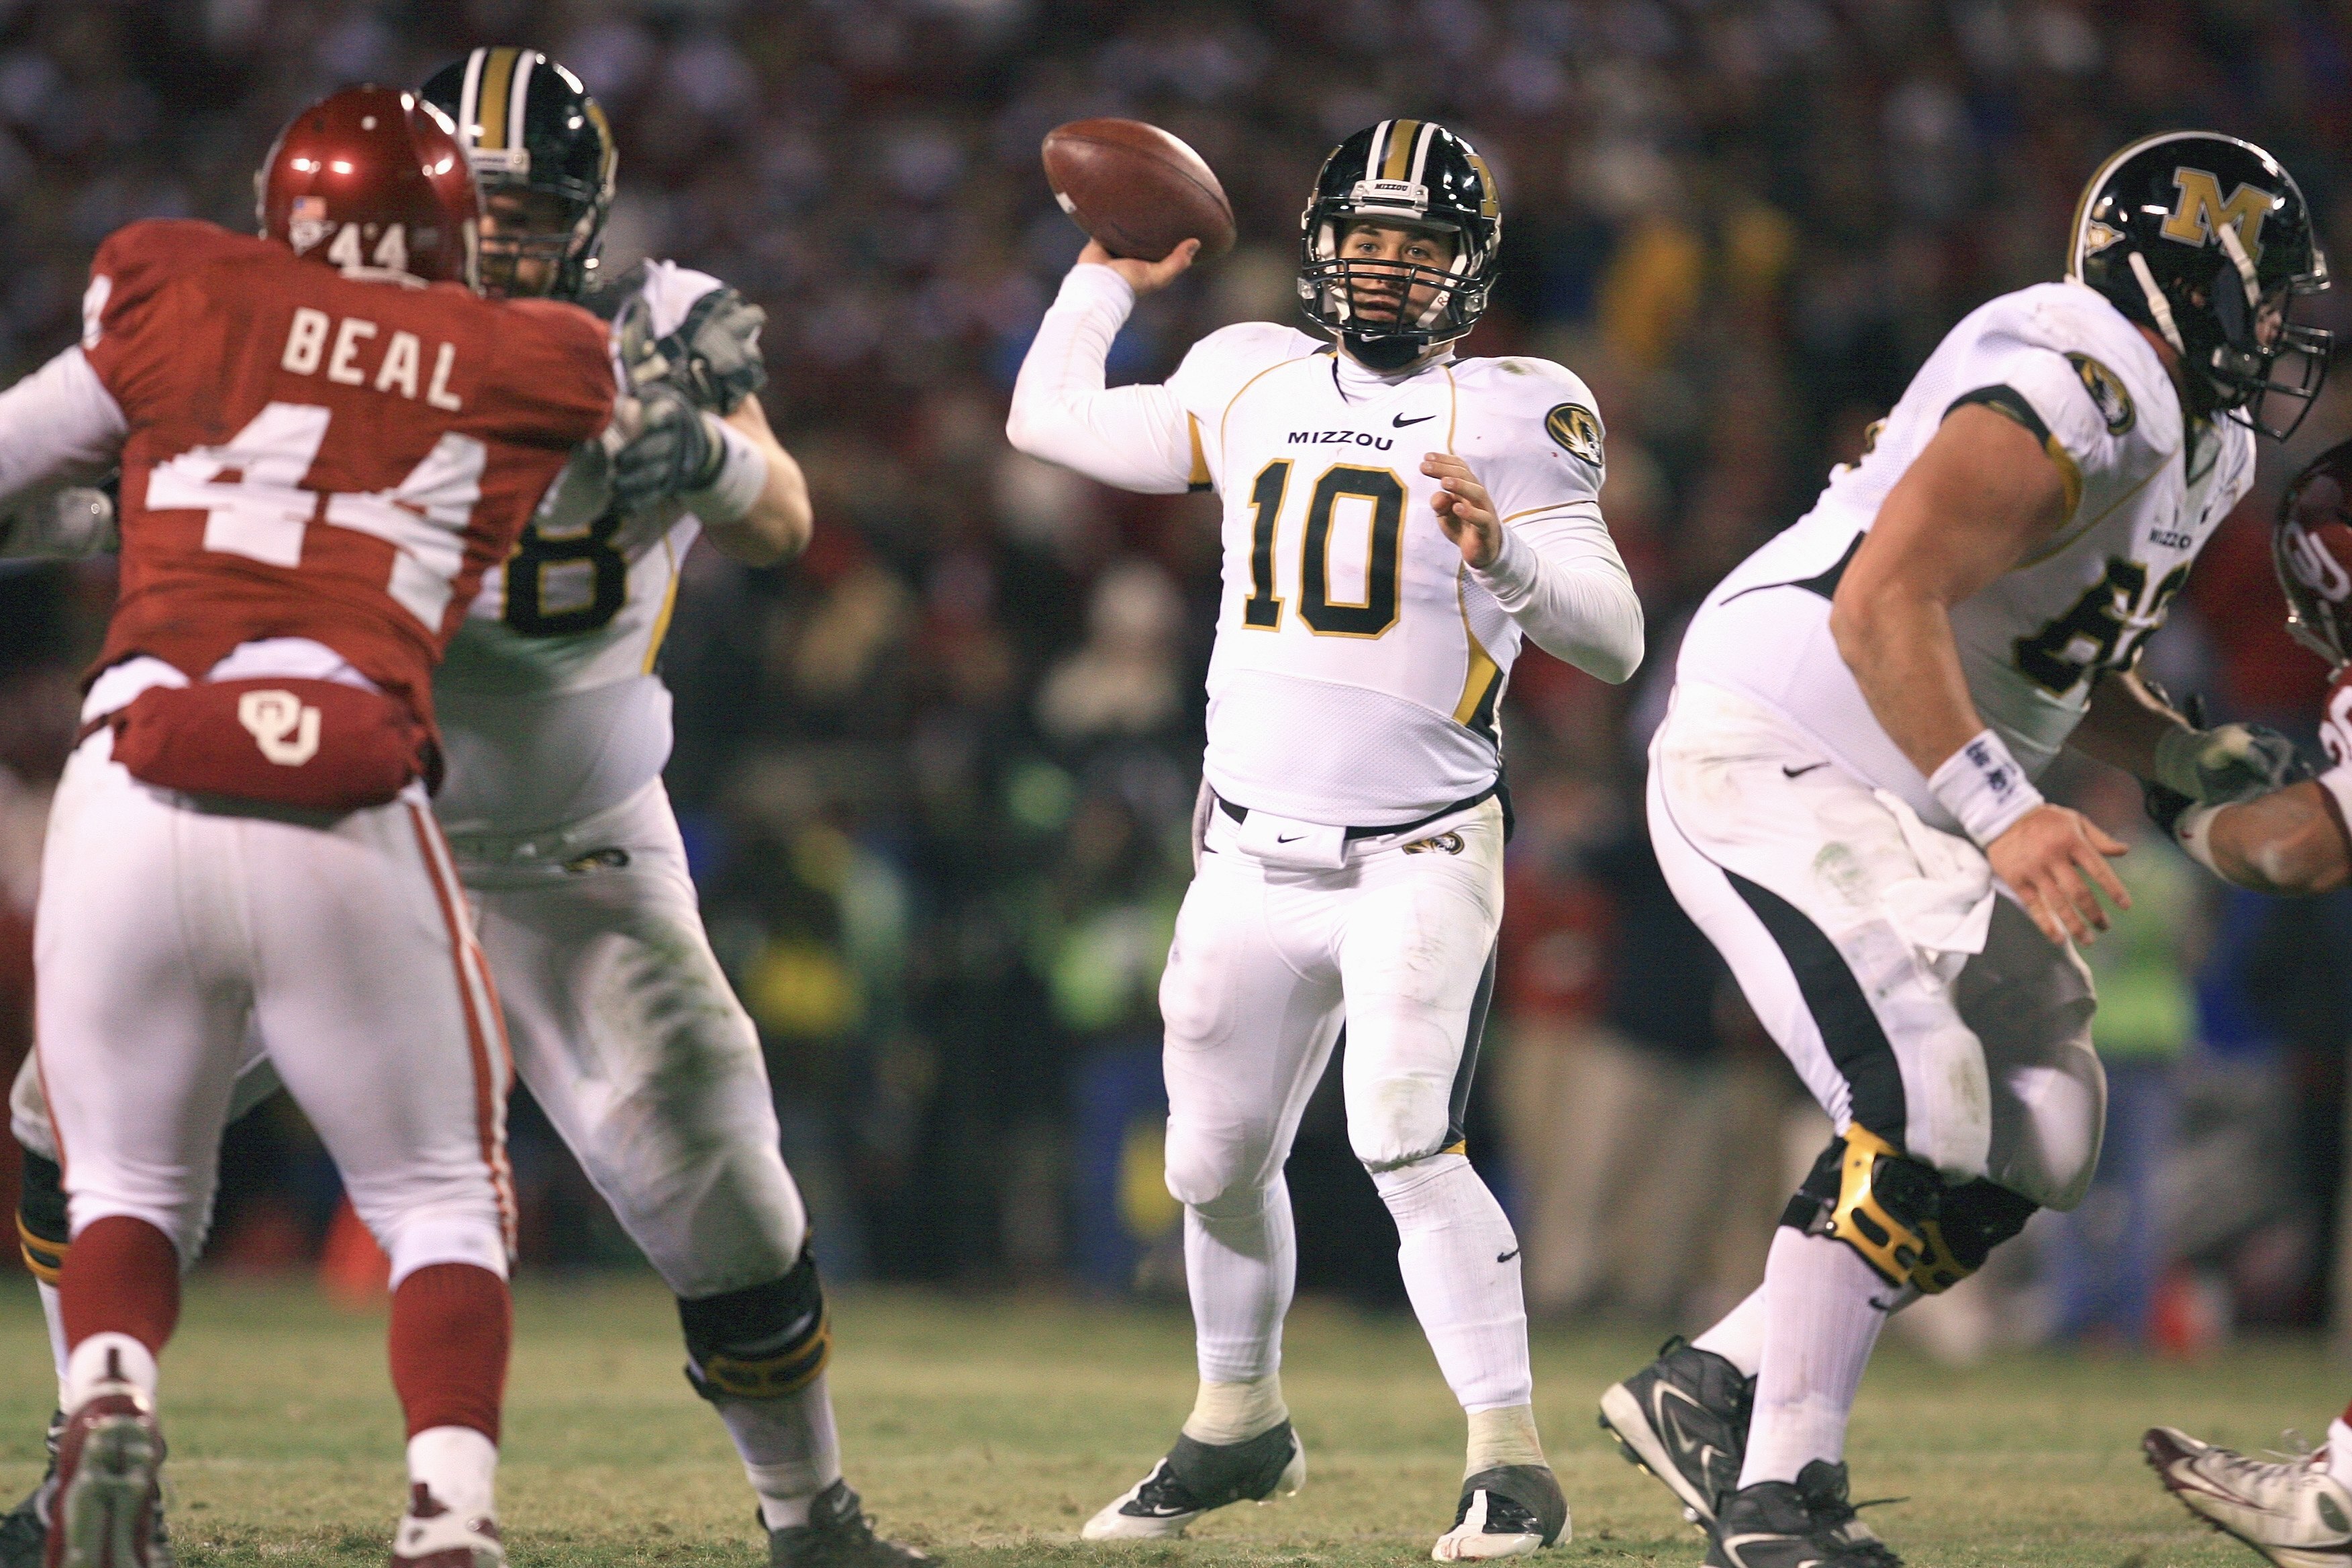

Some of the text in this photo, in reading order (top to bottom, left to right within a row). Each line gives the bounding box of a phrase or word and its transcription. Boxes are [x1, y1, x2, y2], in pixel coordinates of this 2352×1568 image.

[1375, 183, 1408, 191] MIZZOU
[2160, 165, 2276, 265] M
[328, 222, 409, 271] 44
[281, 307, 462, 411] BEAL
[1287, 430, 1394, 451] MIZZOU
[145, 401, 487, 634] 44
[1242, 458, 1408, 640] 10
[238, 689, 322, 767] OU
